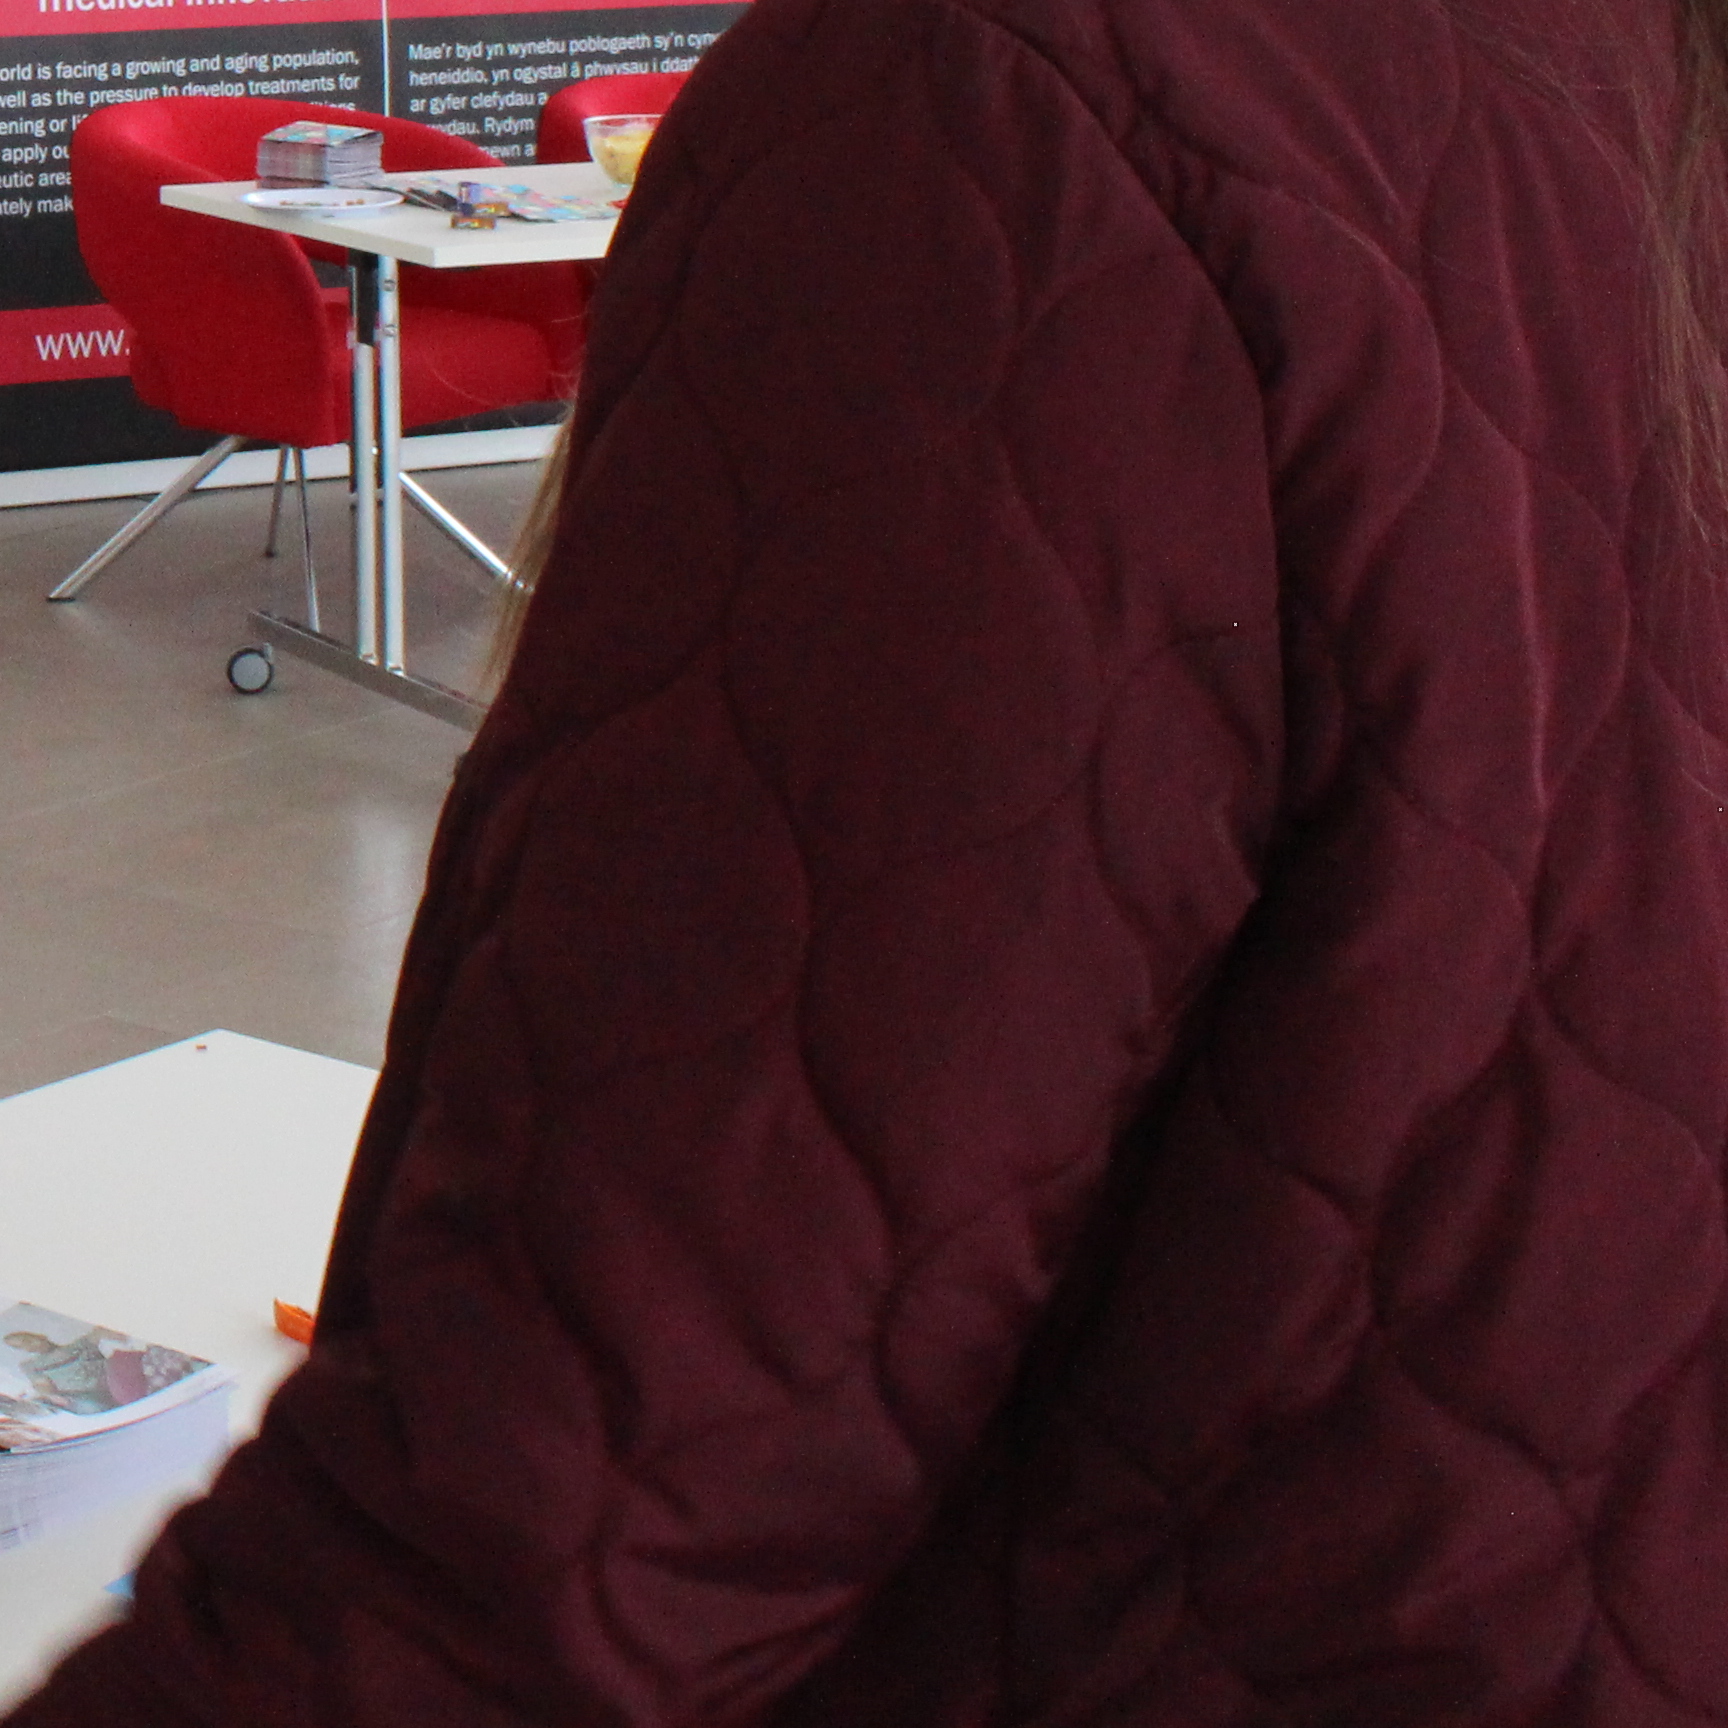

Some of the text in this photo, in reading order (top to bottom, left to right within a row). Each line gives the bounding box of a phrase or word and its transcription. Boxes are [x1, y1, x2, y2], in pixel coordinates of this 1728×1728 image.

[455, 40, 483, 61] byd
[485, 42, 504, 61] yn
[506, 37, 566, 59] wynebu
[36, 61, 52, 81] is
[55, 59, 109, 83] facing
[111, 63, 122, 77] a
[125, 55, 187, 80] growing
[190, 53, 221, 72] and
[224, 51, 269, 75] aging
[272, 47, 360, 73] population,
[30, 90, 52, 108] as
[55, 87, 86, 107] the
[248, 75, 335, 95] treatments
[338, 73, 361, 91] for
[49, 118, 68, 133] or
[1, 142, 48, 165] apply
[35, 329, 131, 361] www.
